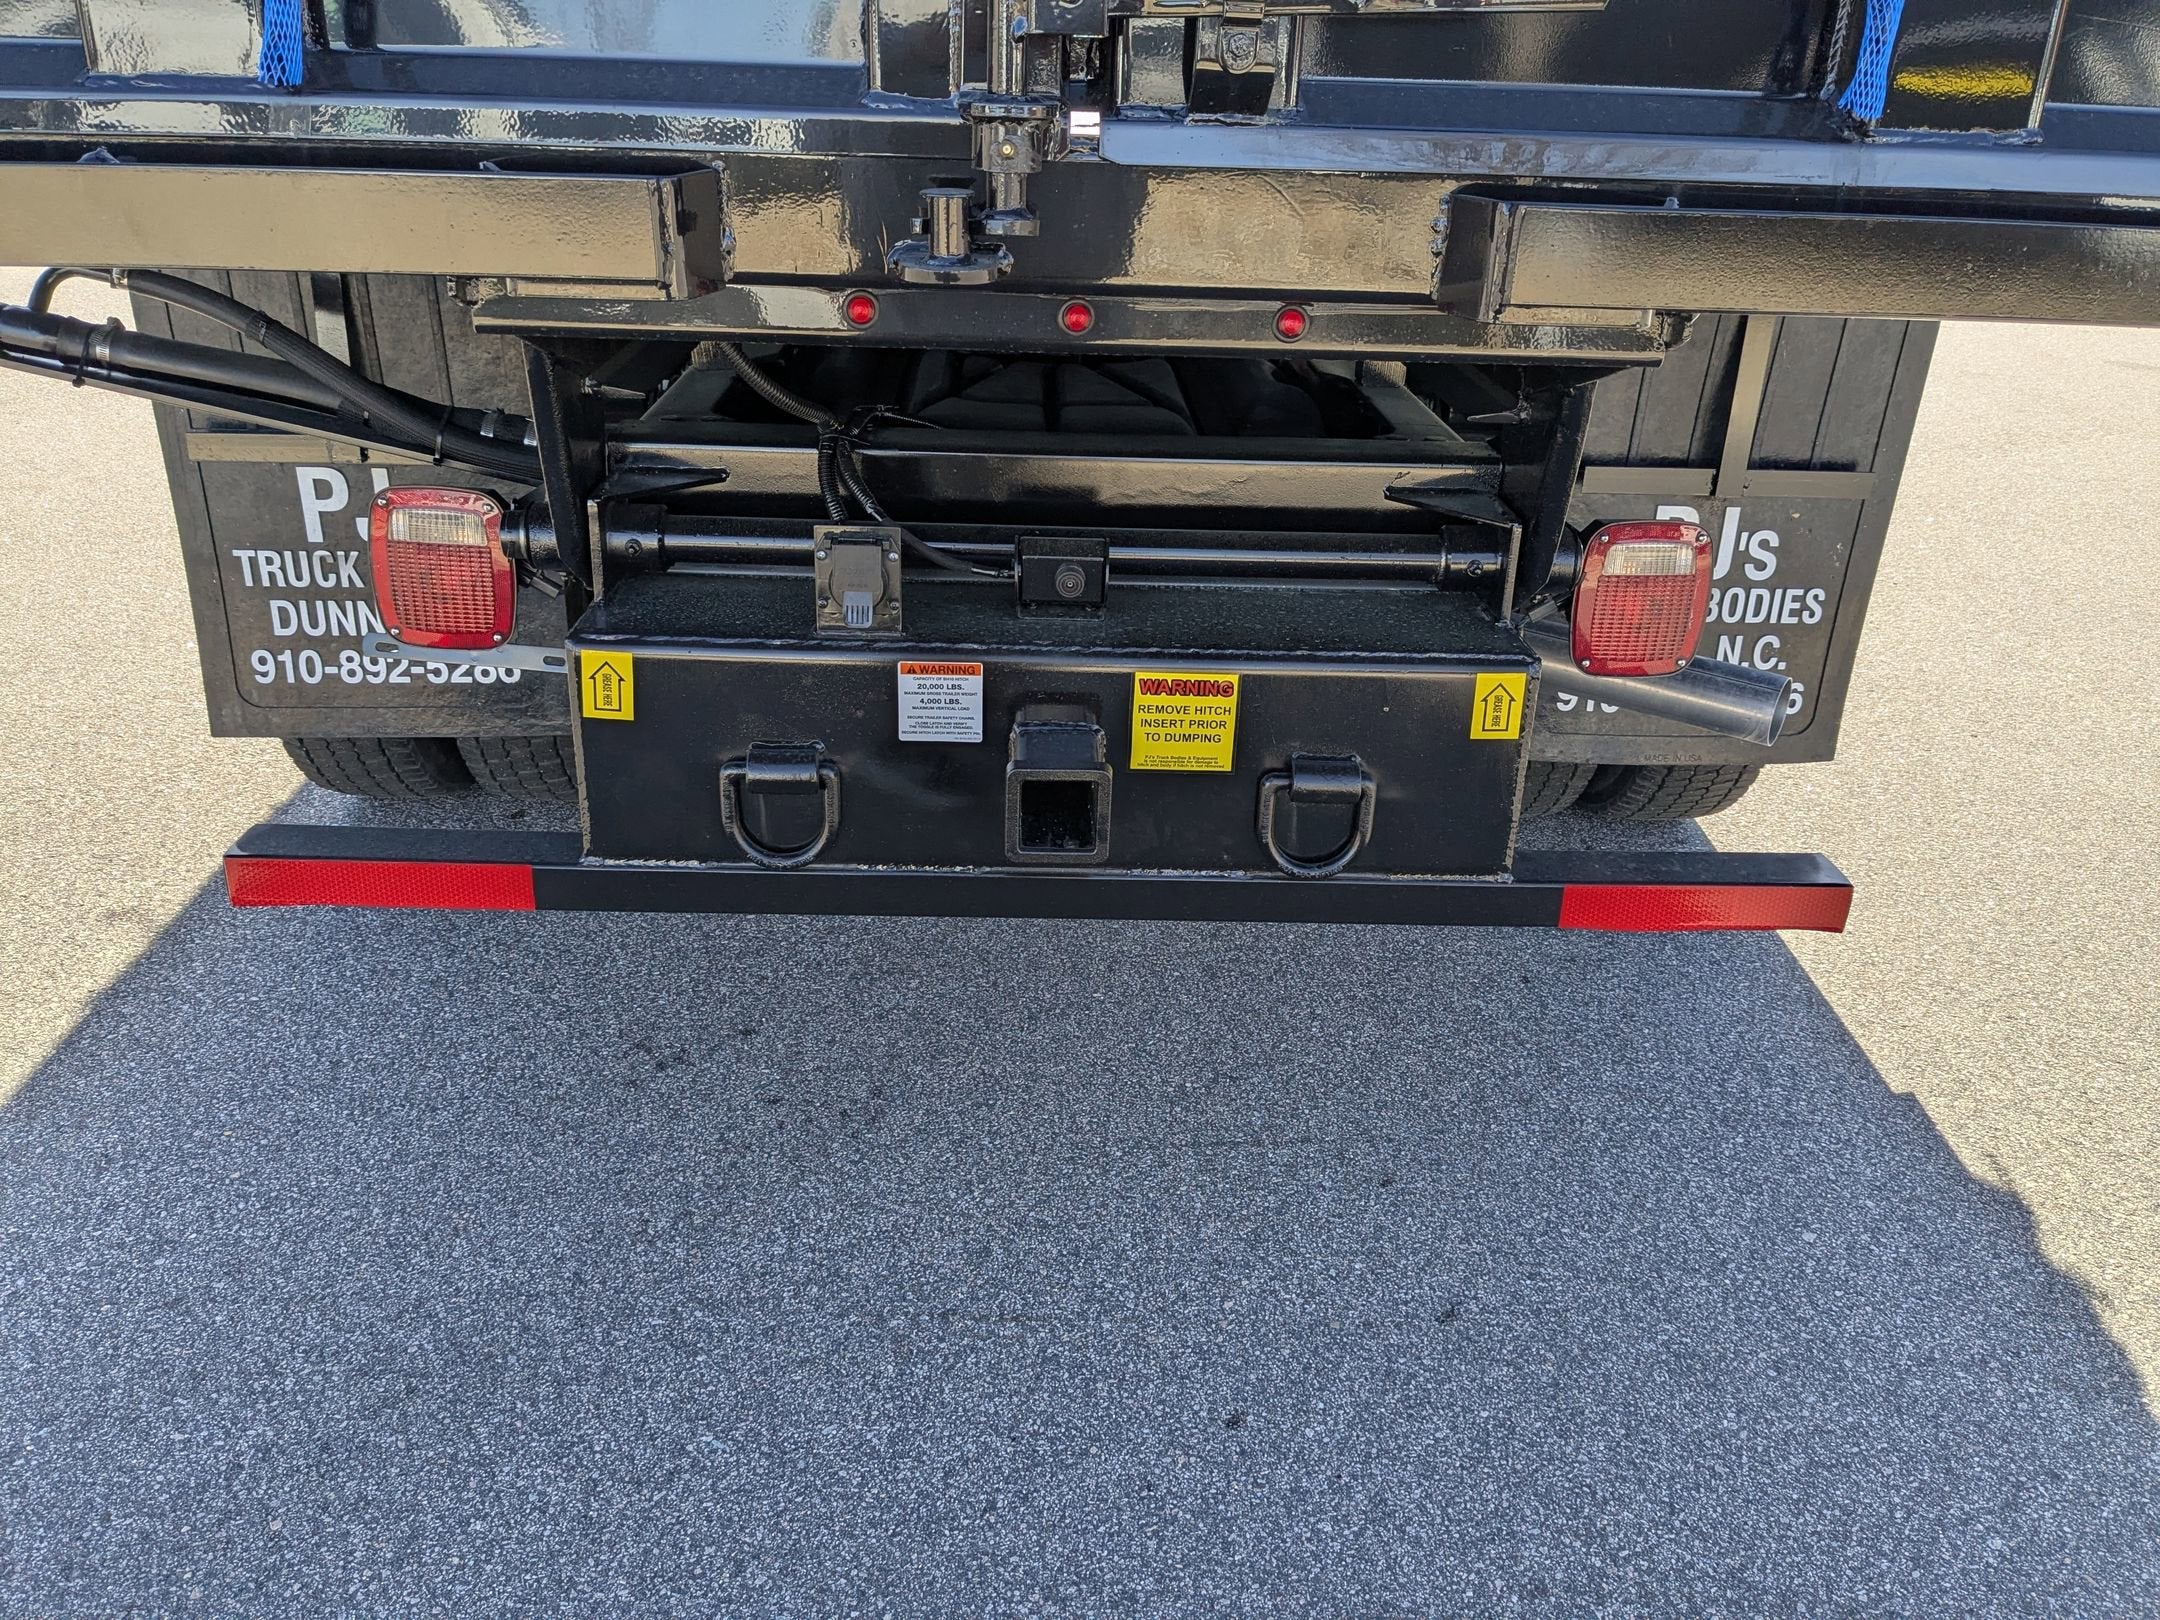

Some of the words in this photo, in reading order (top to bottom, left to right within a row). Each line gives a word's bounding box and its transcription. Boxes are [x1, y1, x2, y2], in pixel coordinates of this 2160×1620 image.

[232, 549, 365, 588] TRUCK
[269, 599, 387, 637] DUNN
[1716, 634, 1787, 670] N.C.
[919, 665, 976, 675] WARNING
[602, 673, 613, 692] GREASE
[1139, 678, 1234, 697] WARNING
[602, 694, 613, 707] HERE
[1492, 695, 1504, 714] GREASE
[1138, 704, 1191, 715] REMOVE
[1195, 705, 1231, 716] HITCH
[1140, 718, 1185, 728] INSERT
[1189, 720, 1227, 730] PRIOR
[1490, 715, 1502, 728] HERE
[1144, 732, 1160, 742] TO
[1164, 733, 1222, 743] DUMPING
[1644, 754, 1670, 762] MADE
[1673, 754, 1681, 762] IN
